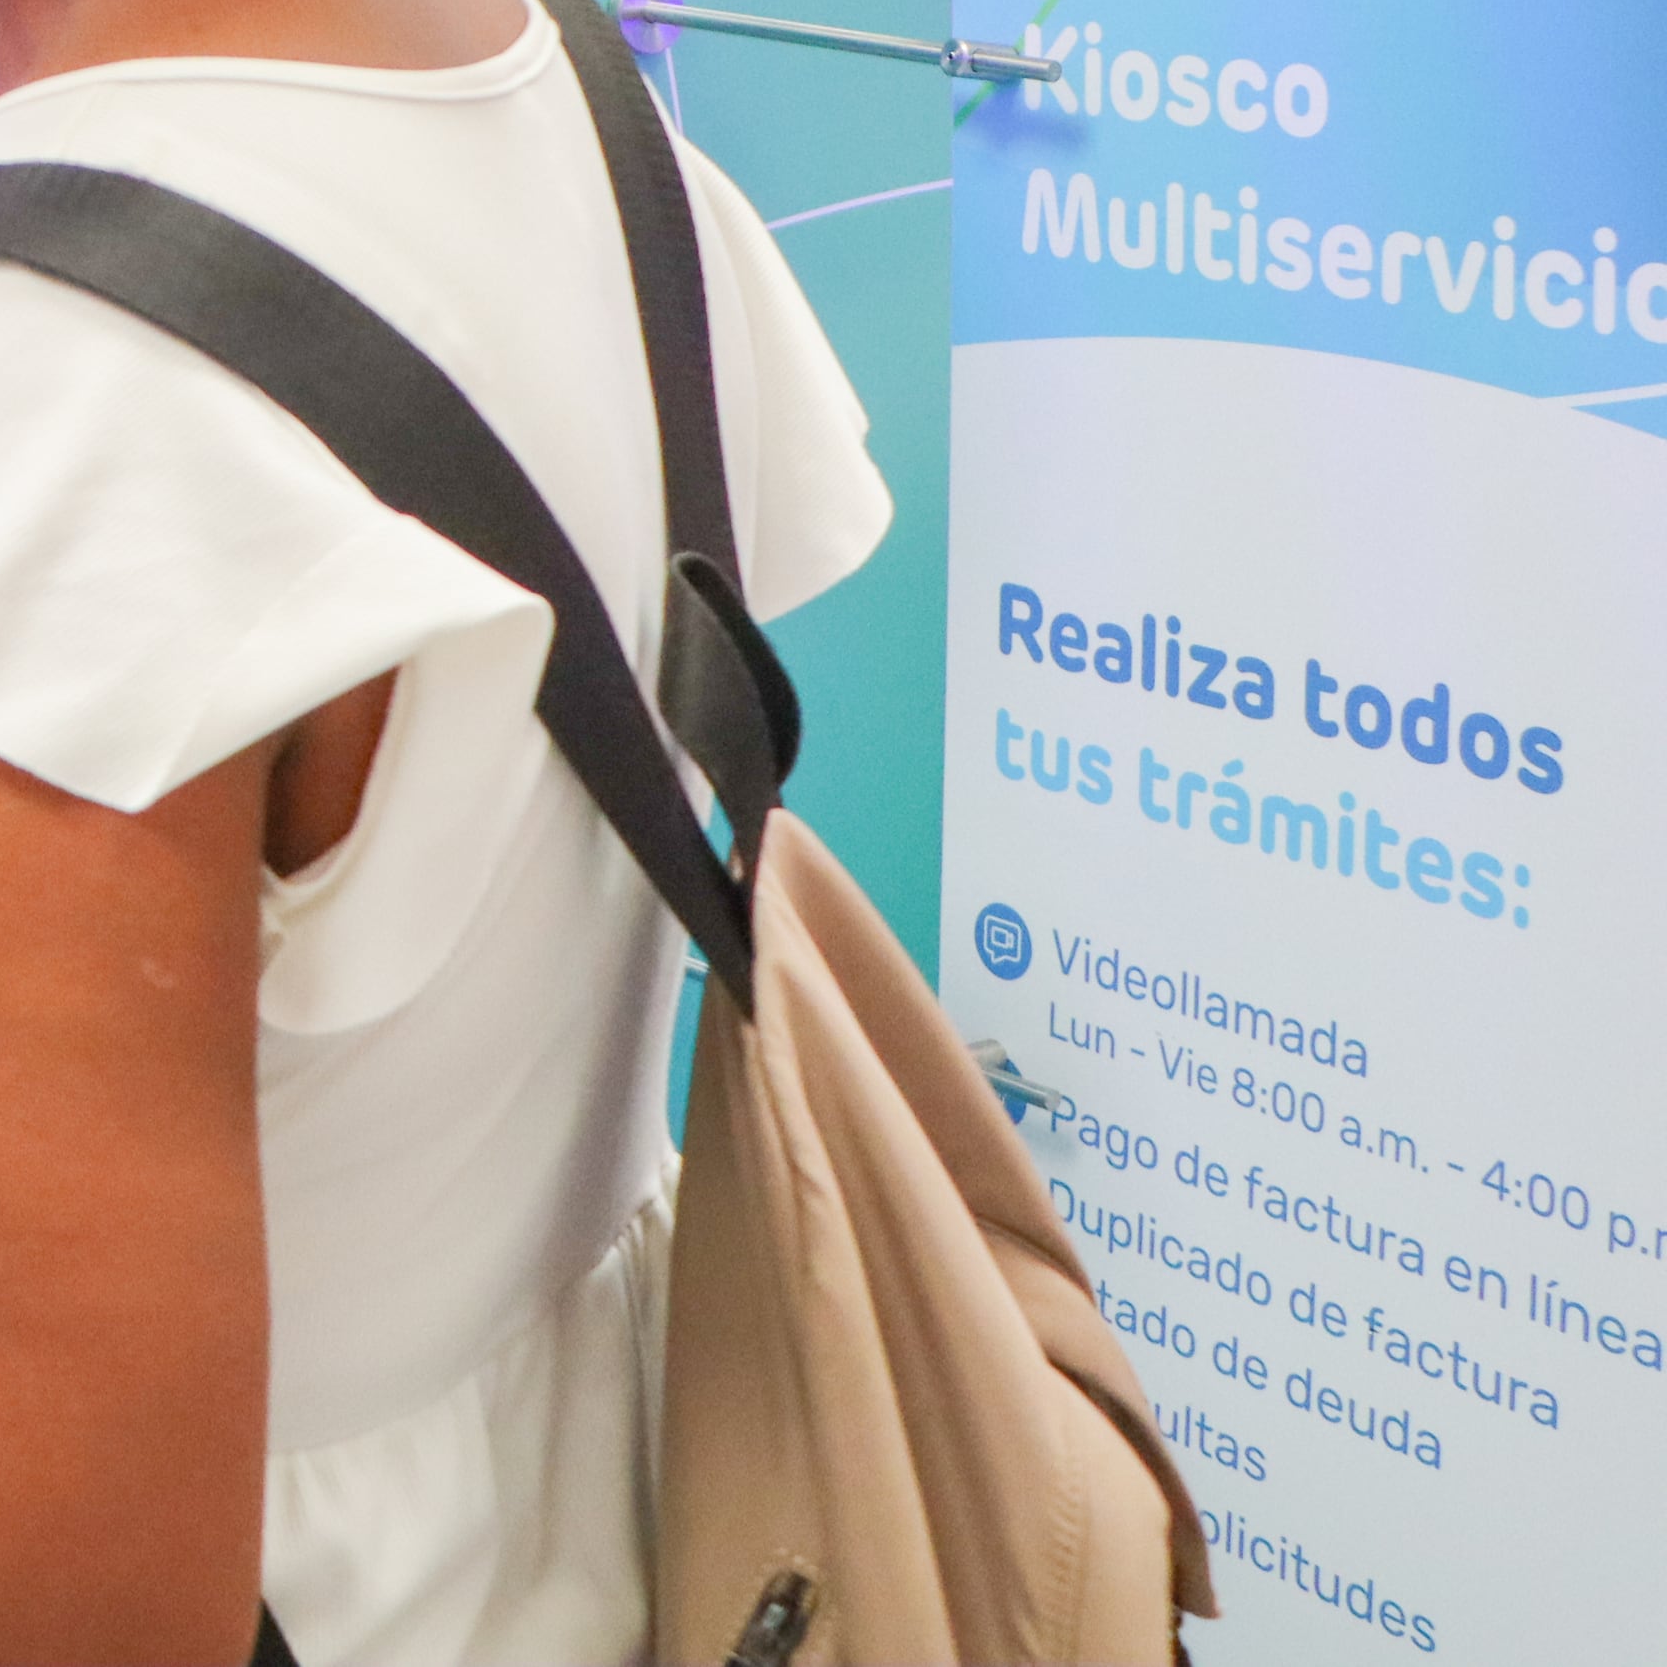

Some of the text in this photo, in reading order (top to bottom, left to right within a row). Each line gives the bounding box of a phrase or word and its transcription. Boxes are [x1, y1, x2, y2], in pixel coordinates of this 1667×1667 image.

[1023, 21, 1329, 138] Kiosco
[1021, 167, 1667, 345] Multiservicio
[997, 582, 1565, 795] Realiza todos
[994, 708, 1531, 930] tus trámites:
[1052, 928, 1369, 1078] Videollamada
[1049, 1000, 1115, 1059] Lun
[1159, 1038, 1218, 1095] Vie
[1232, 1067, 1325, 1134] 8:00
[1339, 1115, 1429, 1174] a.m.
[1481, 1159, 1590, 1232] 4:00
[1048, 1178, 1561, 1430] Duplicado de factura
[1049, 1094, 1663, 1372] Pago de factura en línea
[1212, 1336, 1268, 1392] de
[1285, 1359, 1444, 1470] deuda
